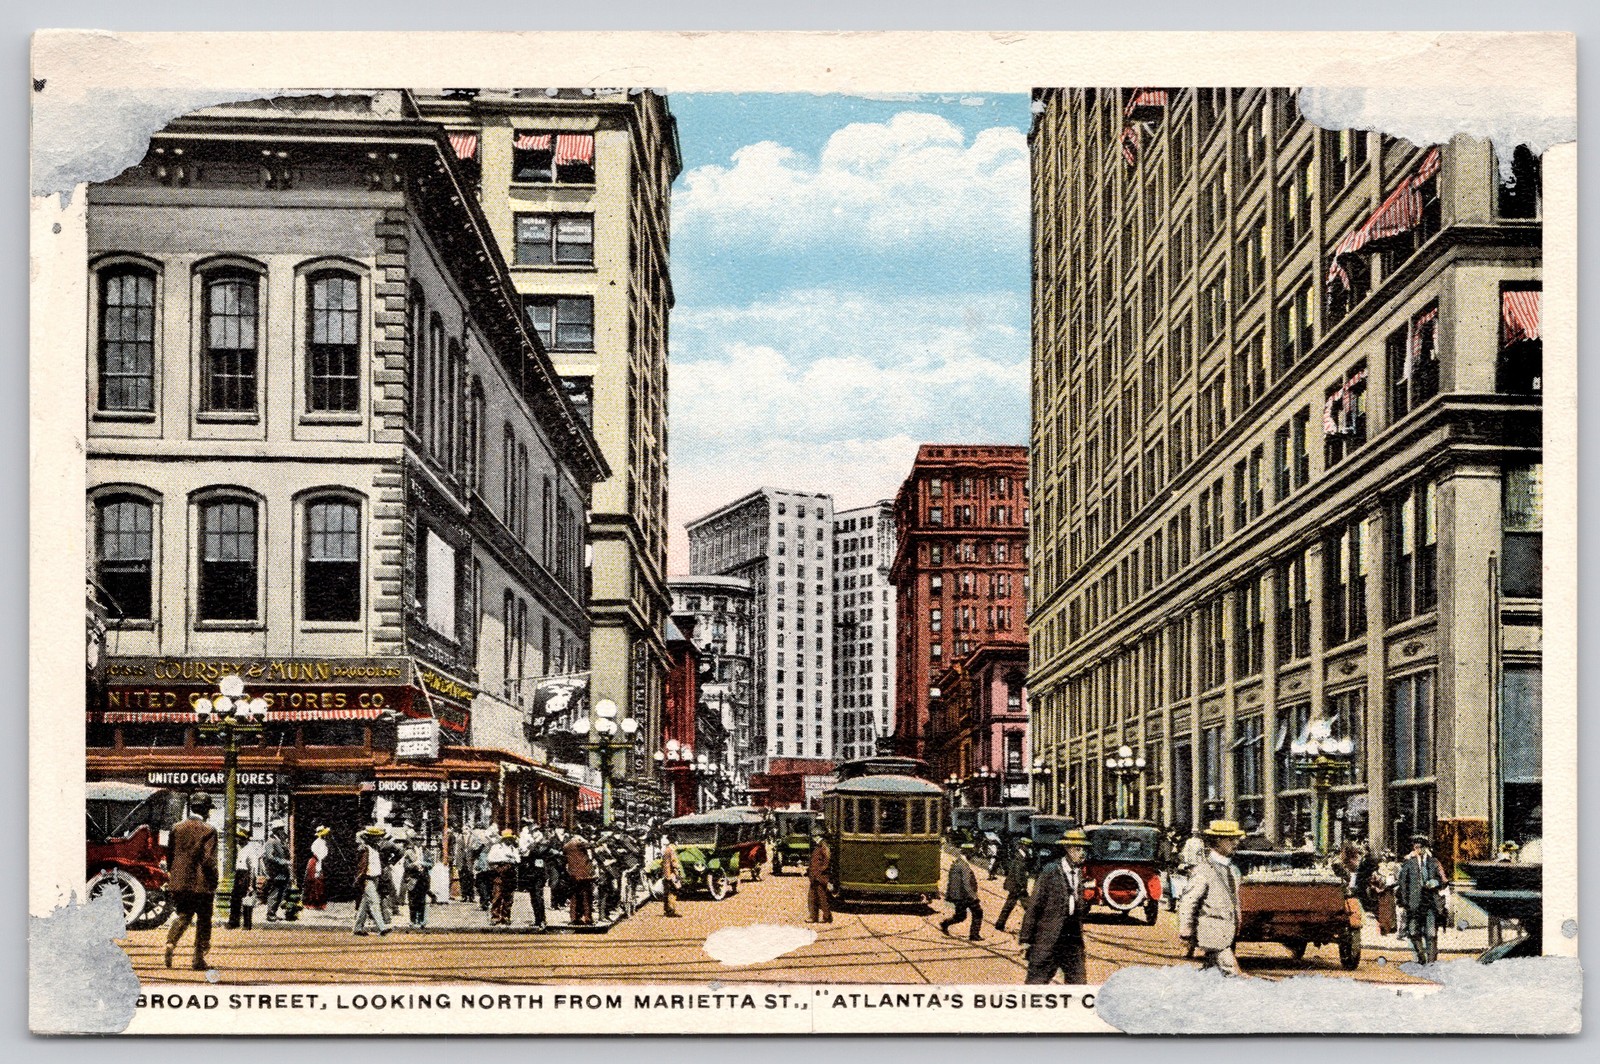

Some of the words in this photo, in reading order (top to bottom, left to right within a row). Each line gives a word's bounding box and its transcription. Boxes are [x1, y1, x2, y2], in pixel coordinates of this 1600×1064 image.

[247, 661, 266, 678] &
[267, 660, 331, 681] MUNN
[108, 691, 177, 708] NITED
[263, 692, 347, 708] STORES
[148, 772, 188, 784] UNITED
[190, 772, 225, 785] CIGAR
[236, 772, 274, 785] TORES
[378, 780, 408, 791] DRUGS
[412, 780, 438, 792] DRUGS
